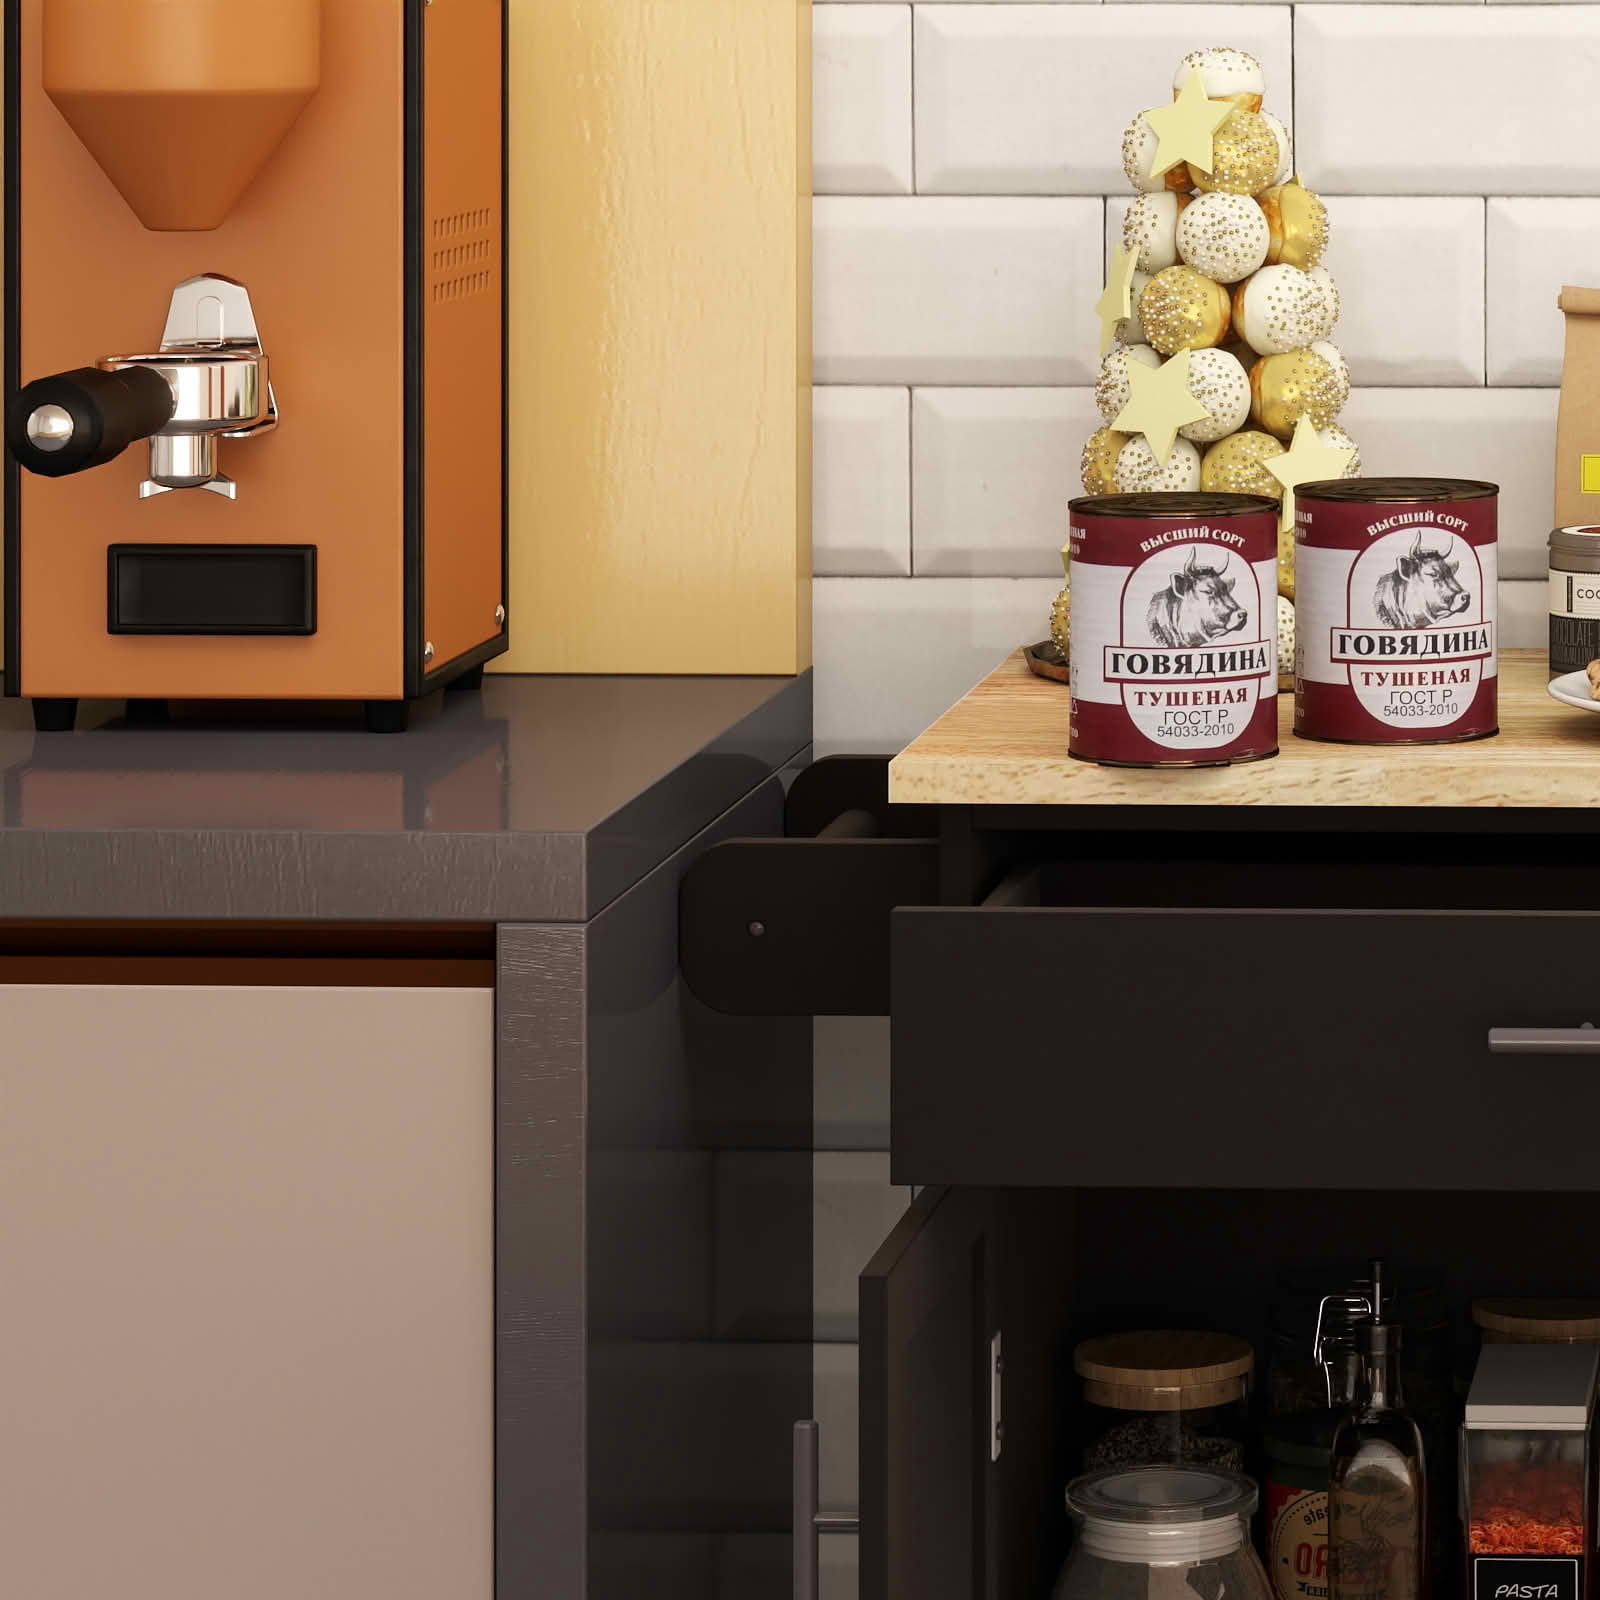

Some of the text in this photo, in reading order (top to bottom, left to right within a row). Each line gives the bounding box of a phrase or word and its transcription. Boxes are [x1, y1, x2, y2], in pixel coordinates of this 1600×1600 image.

[1366, 509, 1470, 537] ВЫСШИЙ СОРТ
[1140, 525, 1246, 553] ВЫСШИЙ СОРТ
[1338, 628, 1489, 660] ГОВЯДИНА
[1111, 646, 1267, 679] ГОВЯДИНА
[1360, 668, 1471, 688] ТУШЕНАЯ
[1134, 687, 1248, 707] ТУШЕНАЯ
[1390, 690, 1438, 705] ГОСТ
[1163, 710, 1213, 726] ГОСТ
[1383, 703, 1459, 717] 54033-2010
[1157, 723, 1235, 738] 54033-2010
[1494, 1583, 1558, 1599] PASTA
